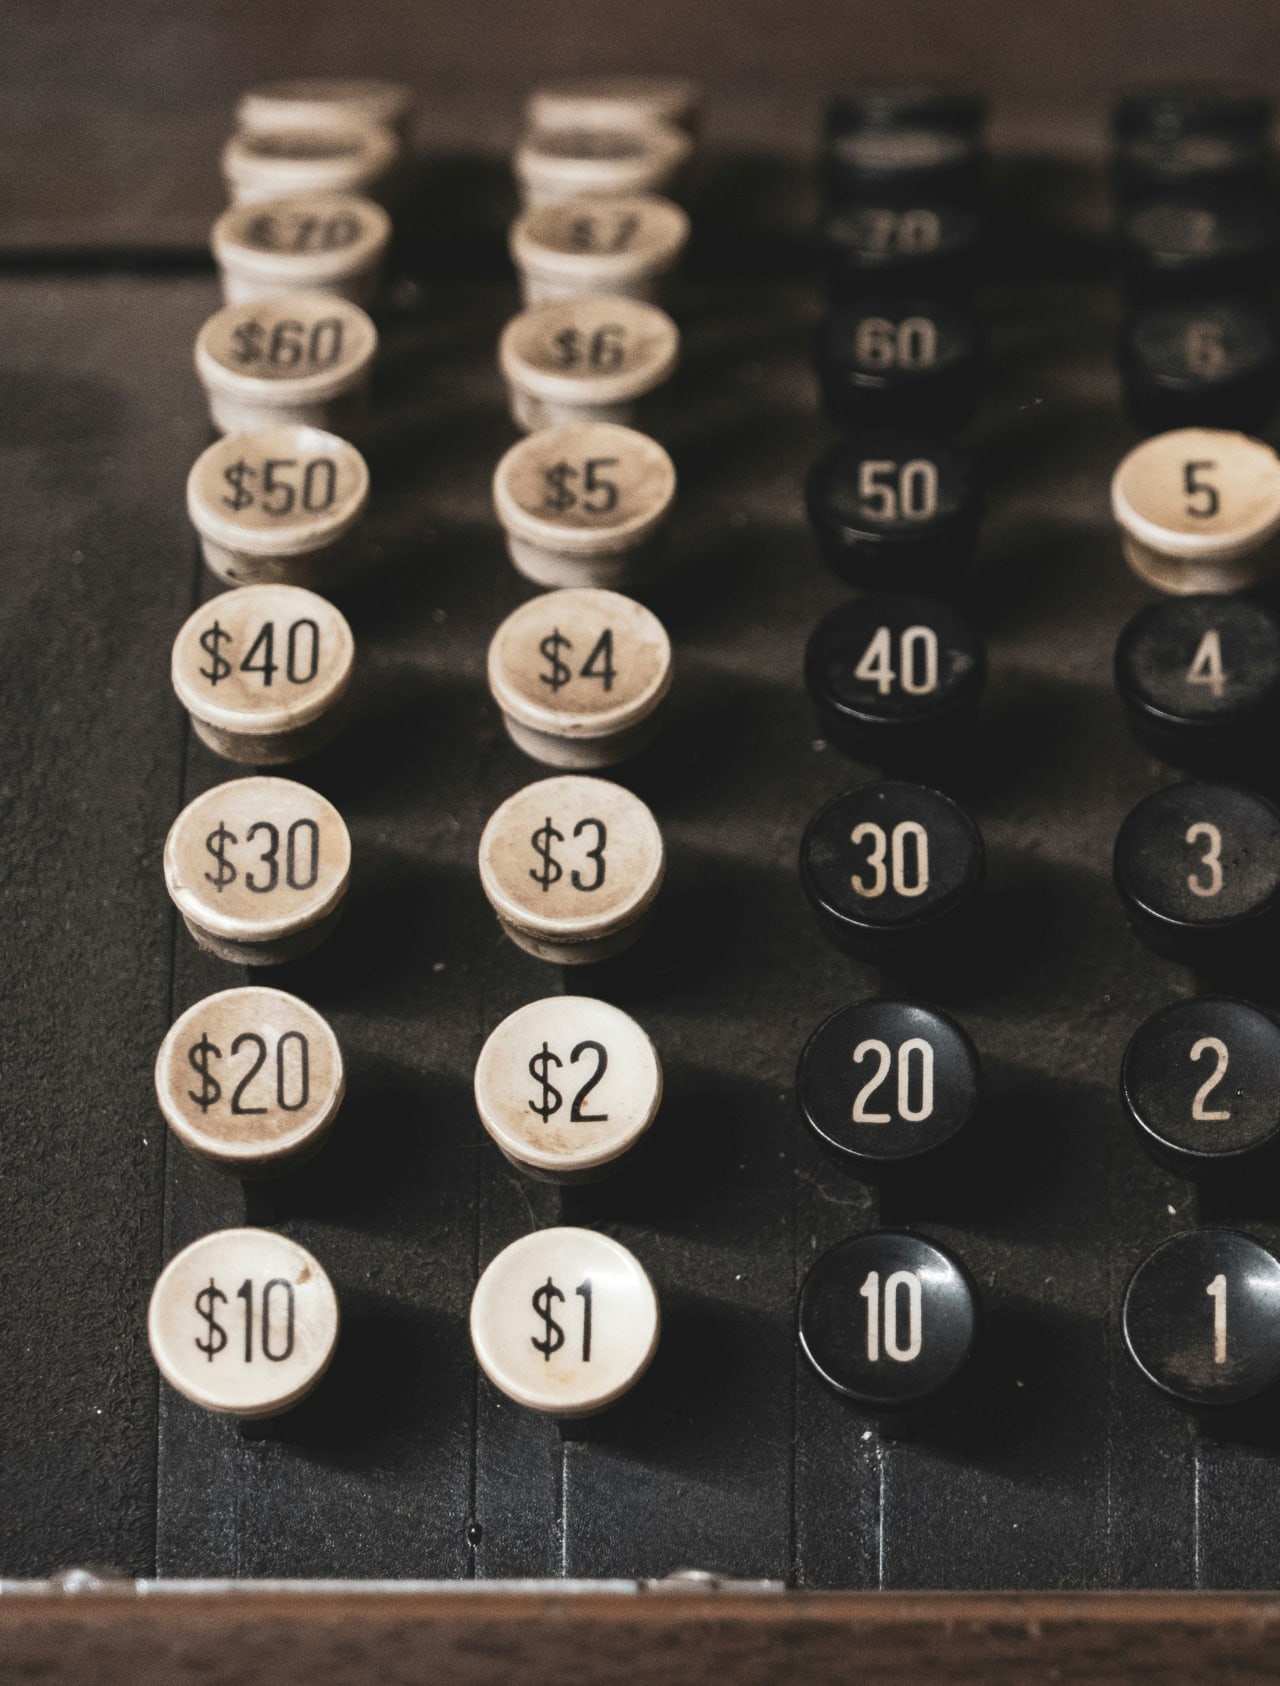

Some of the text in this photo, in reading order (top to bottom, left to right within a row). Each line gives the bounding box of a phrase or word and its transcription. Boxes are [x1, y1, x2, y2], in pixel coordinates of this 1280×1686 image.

[232, 318, 344, 369] $60
[553, 323, 626, 371] $6
[856, 317, 937, 370] 60
[223, 458, 337, 518] $50
[543, 457, 619, 516] $5
[858, 460, 938, 520] 50
[1183, 461, 1220, 520] 5
[199, 618, 320, 688] $40
[539, 628, 617, 693] $4
[855, 625, 938, 695] 40
[1186, 630, 1226, 696] 4
[204, 817, 320, 894] $30
[528, 817, 607, 893] $3
[851, 821, 929, 898] 30
[1185, 822, 1223, 897] 3
[188, 1031, 310, 1116] $20
[528, 1040, 608, 1124] $2
[852, 1037, 935, 1124] 20
[1189, 1036, 1231, 1121] 2
[194, 1278, 295, 1363] $10
[531, 1276, 594, 1363] $1
[859, 1270, 922, 1362] 10
[1206, 1273, 1228, 1364] 1
